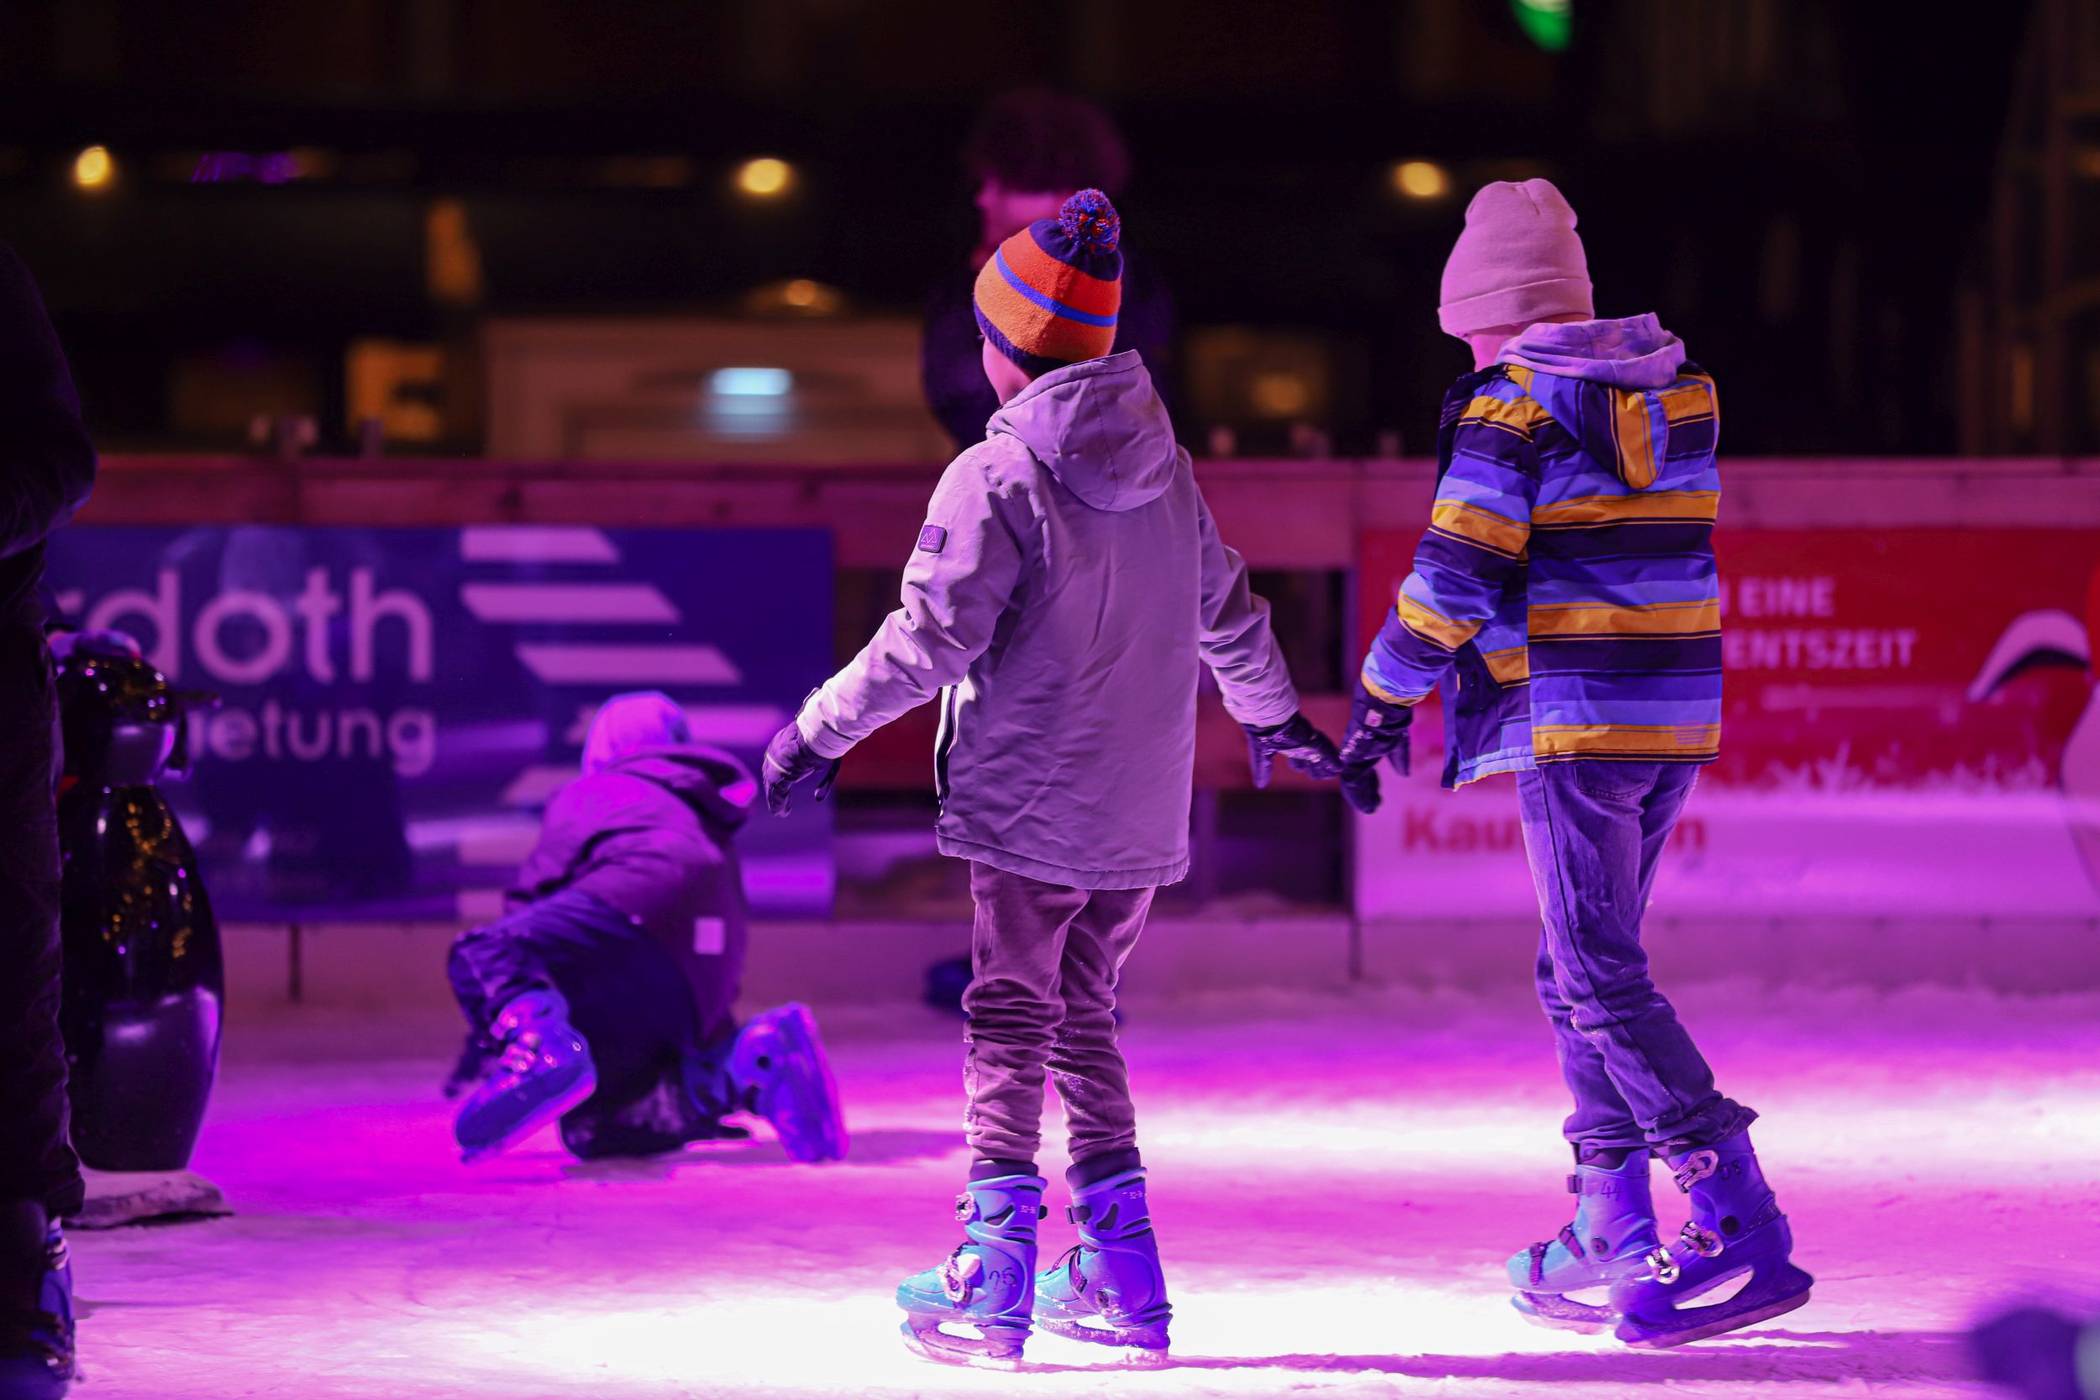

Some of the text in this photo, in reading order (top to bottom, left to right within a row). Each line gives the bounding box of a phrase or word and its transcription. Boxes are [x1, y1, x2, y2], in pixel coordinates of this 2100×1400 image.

[1740, 578, 1834, 617] EINE
[1725, 629, 1917, 669] ENTSZEIT
[187, 701, 437, 778] ietung
